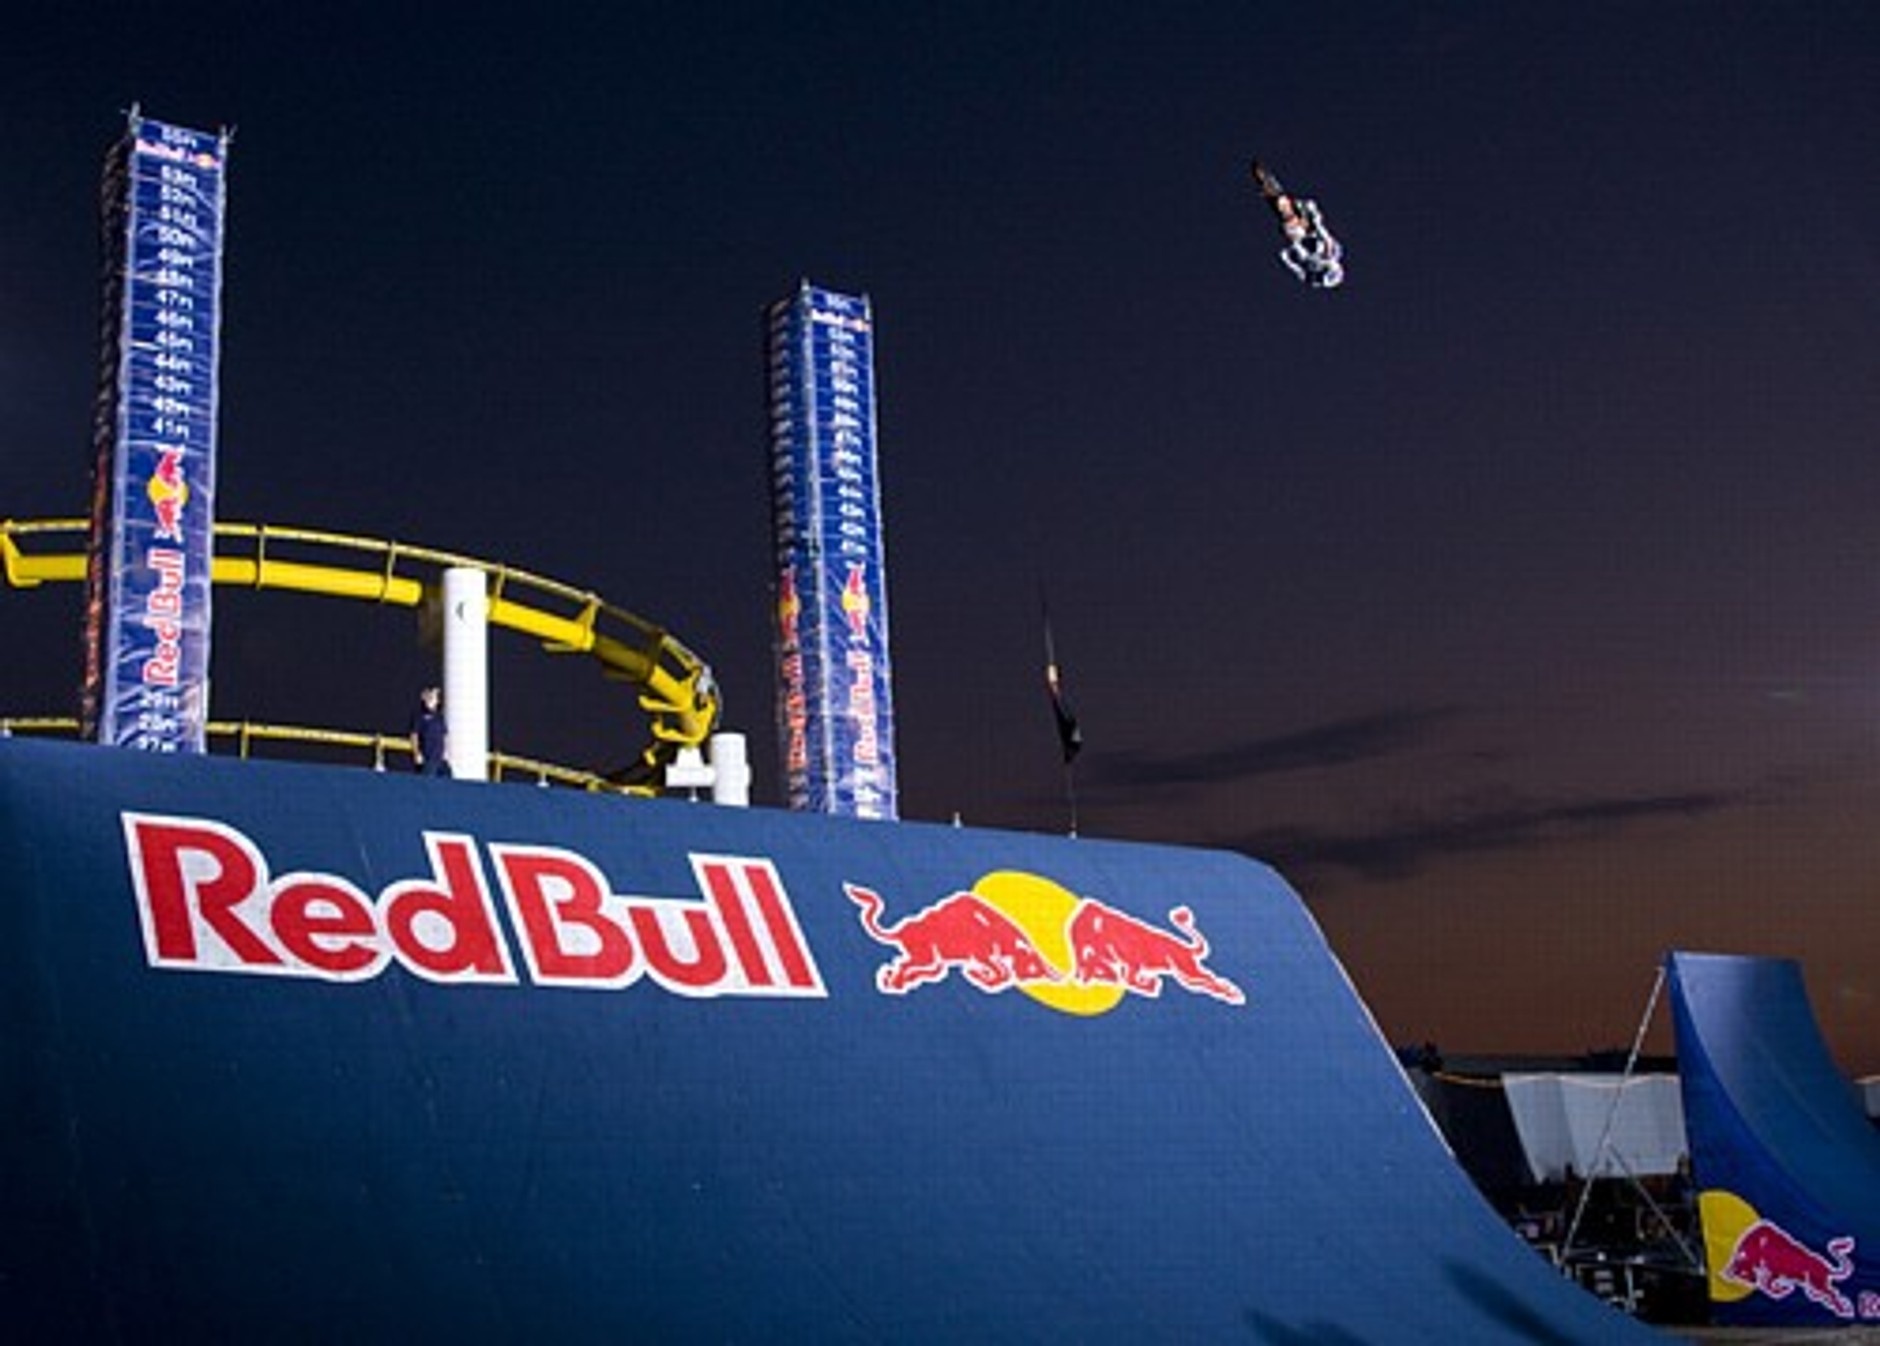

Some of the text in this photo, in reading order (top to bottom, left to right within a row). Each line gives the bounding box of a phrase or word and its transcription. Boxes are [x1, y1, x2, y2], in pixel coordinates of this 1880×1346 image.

[143, 547, 185, 687] Red Bull
[121, 811, 829, 998] Red Bull
